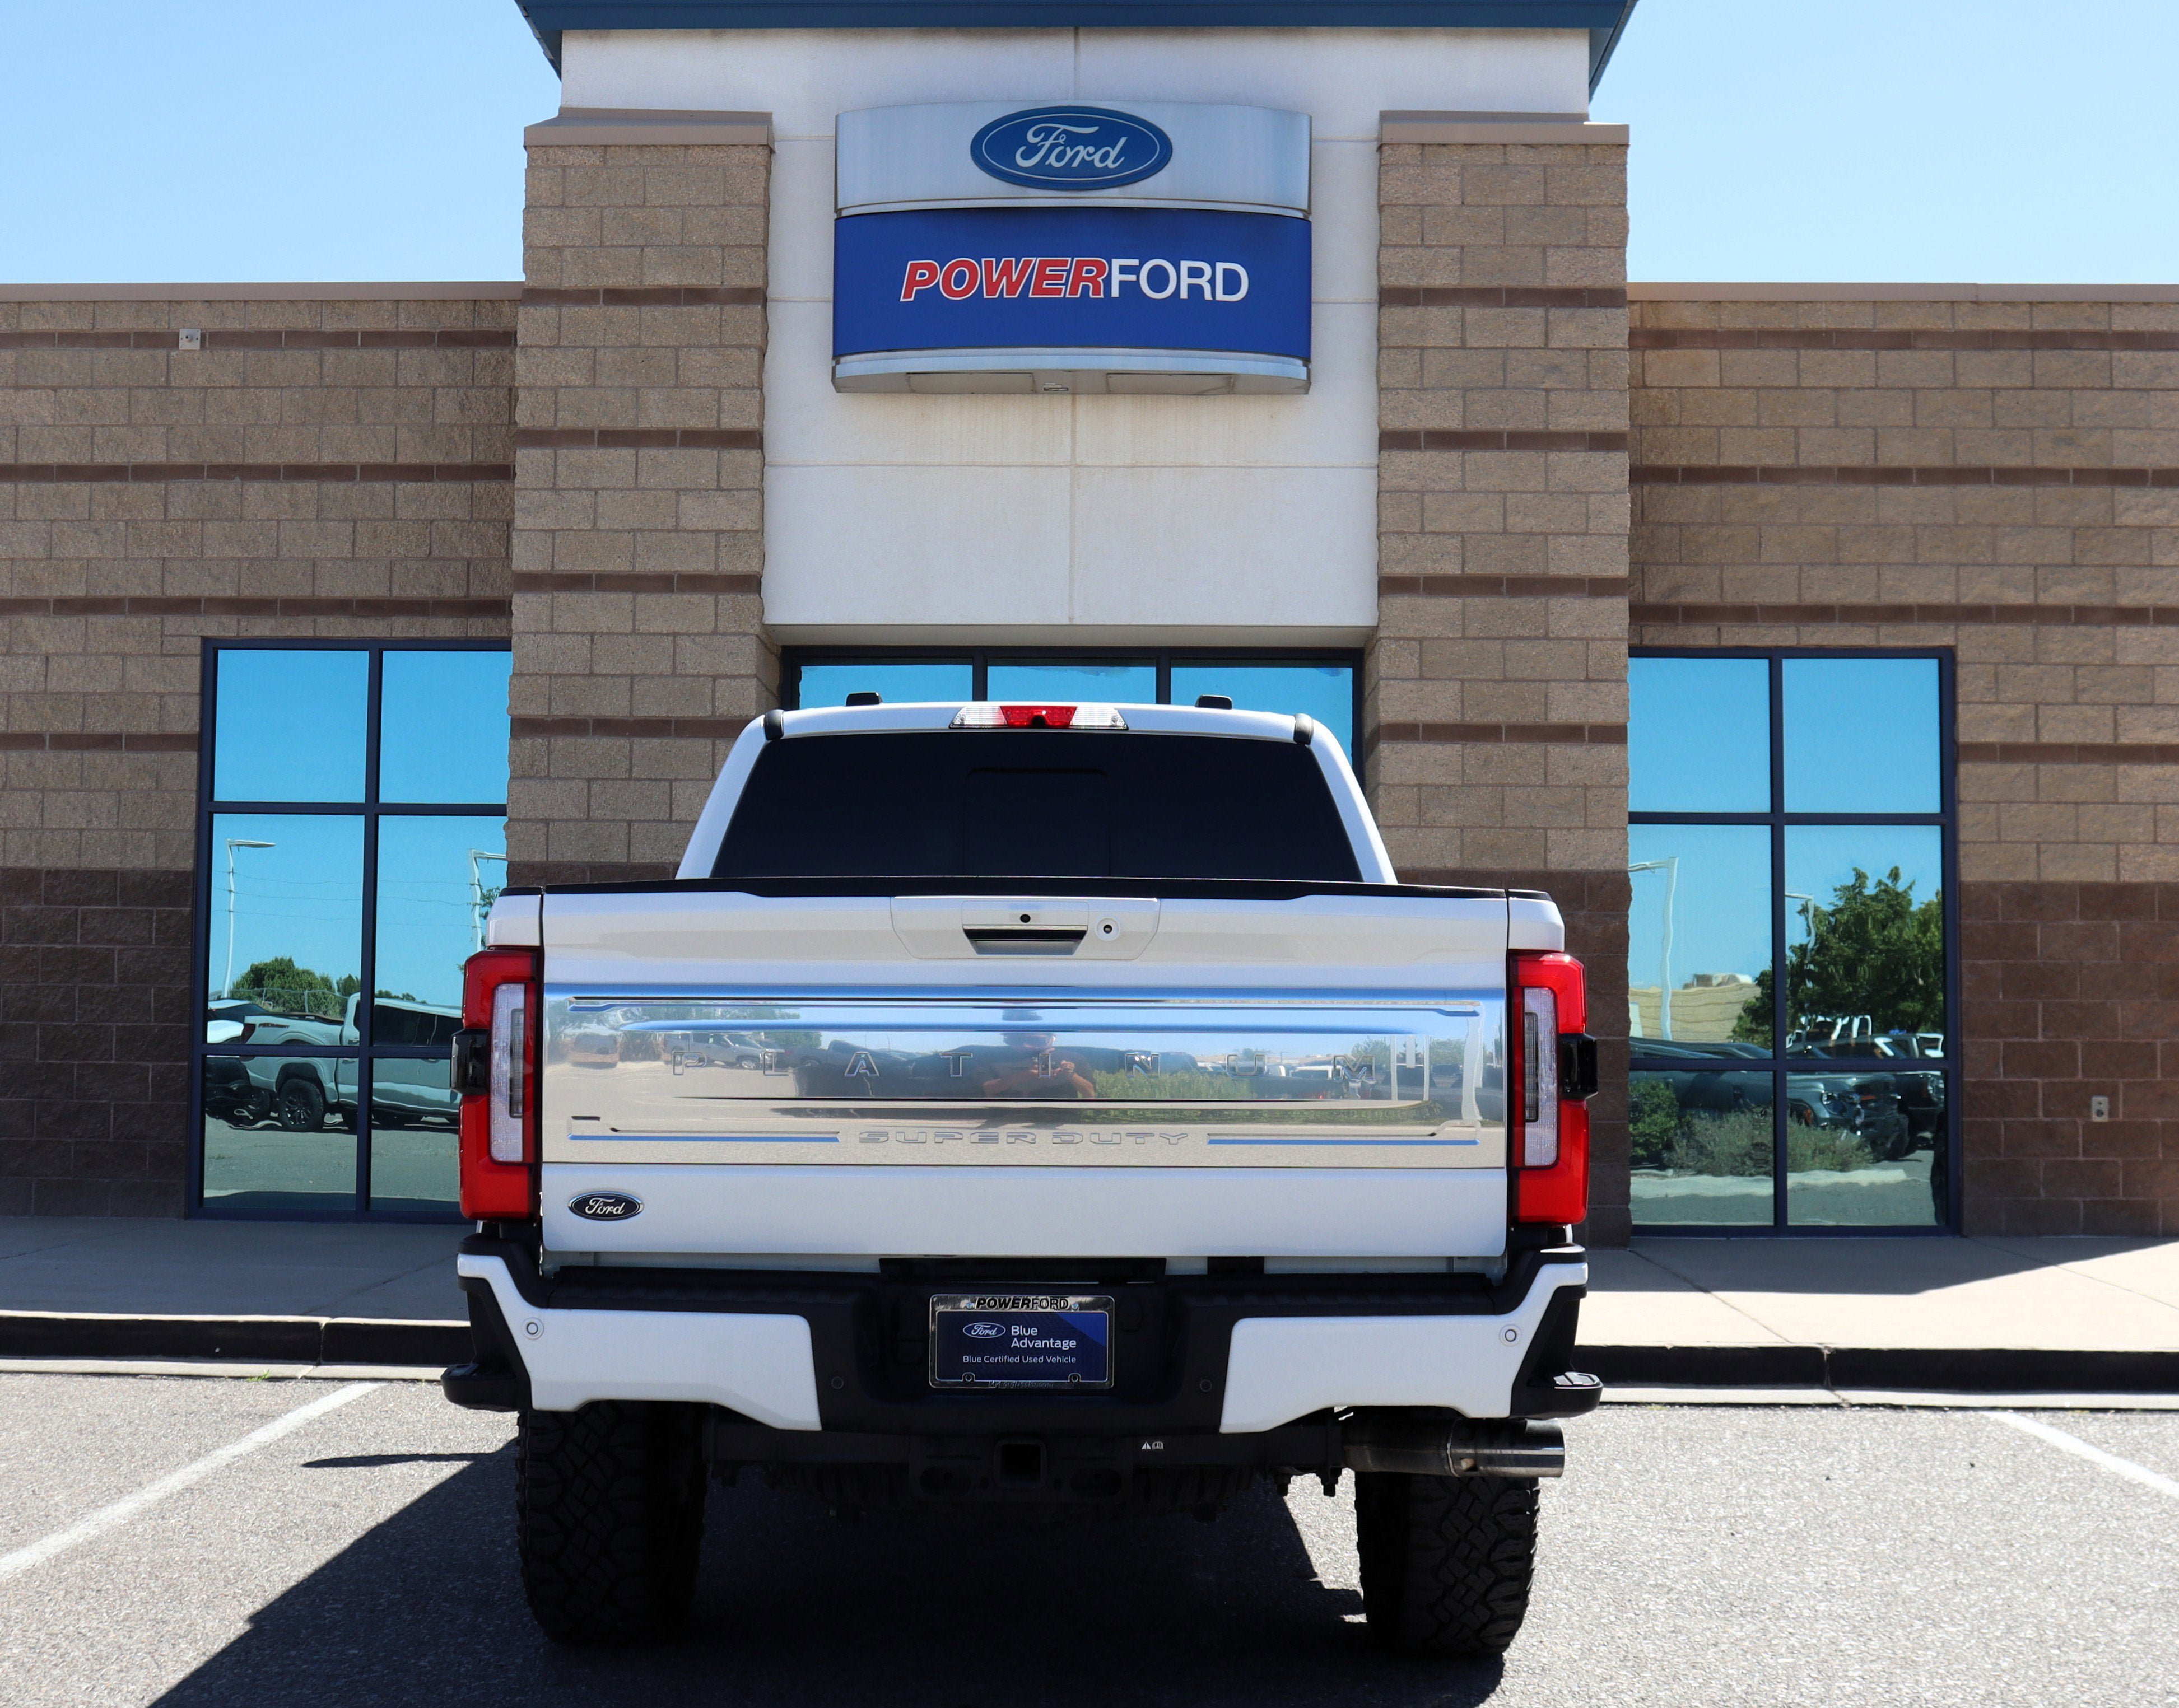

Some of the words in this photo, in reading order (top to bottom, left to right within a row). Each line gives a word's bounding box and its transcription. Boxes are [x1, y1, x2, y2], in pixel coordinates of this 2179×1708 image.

[1014, 123, 1125, 169] Ford
[900, 256, 1250, 302] POWERFORD
[672, 1051, 1376, 1080] PLATINUM
[859, 1131, 1037, 1145] SUPER
[1051, 1132, 1188, 1145] DUTY
[585, 1197, 626, 1215] Ford
[976, 1298, 1069, 1310] POWERFORD
[971, 1324, 998, 1336] Ford
[1011, 1325, 1038, 1336] Blue
[1011, 1337, 1077, 1350] Advantage
[984, 1355, 1020, 1364] Certified
[1022, 1355, 1044, 1364] Used
[1046, 1355, 1076, 1364] Vehicle
